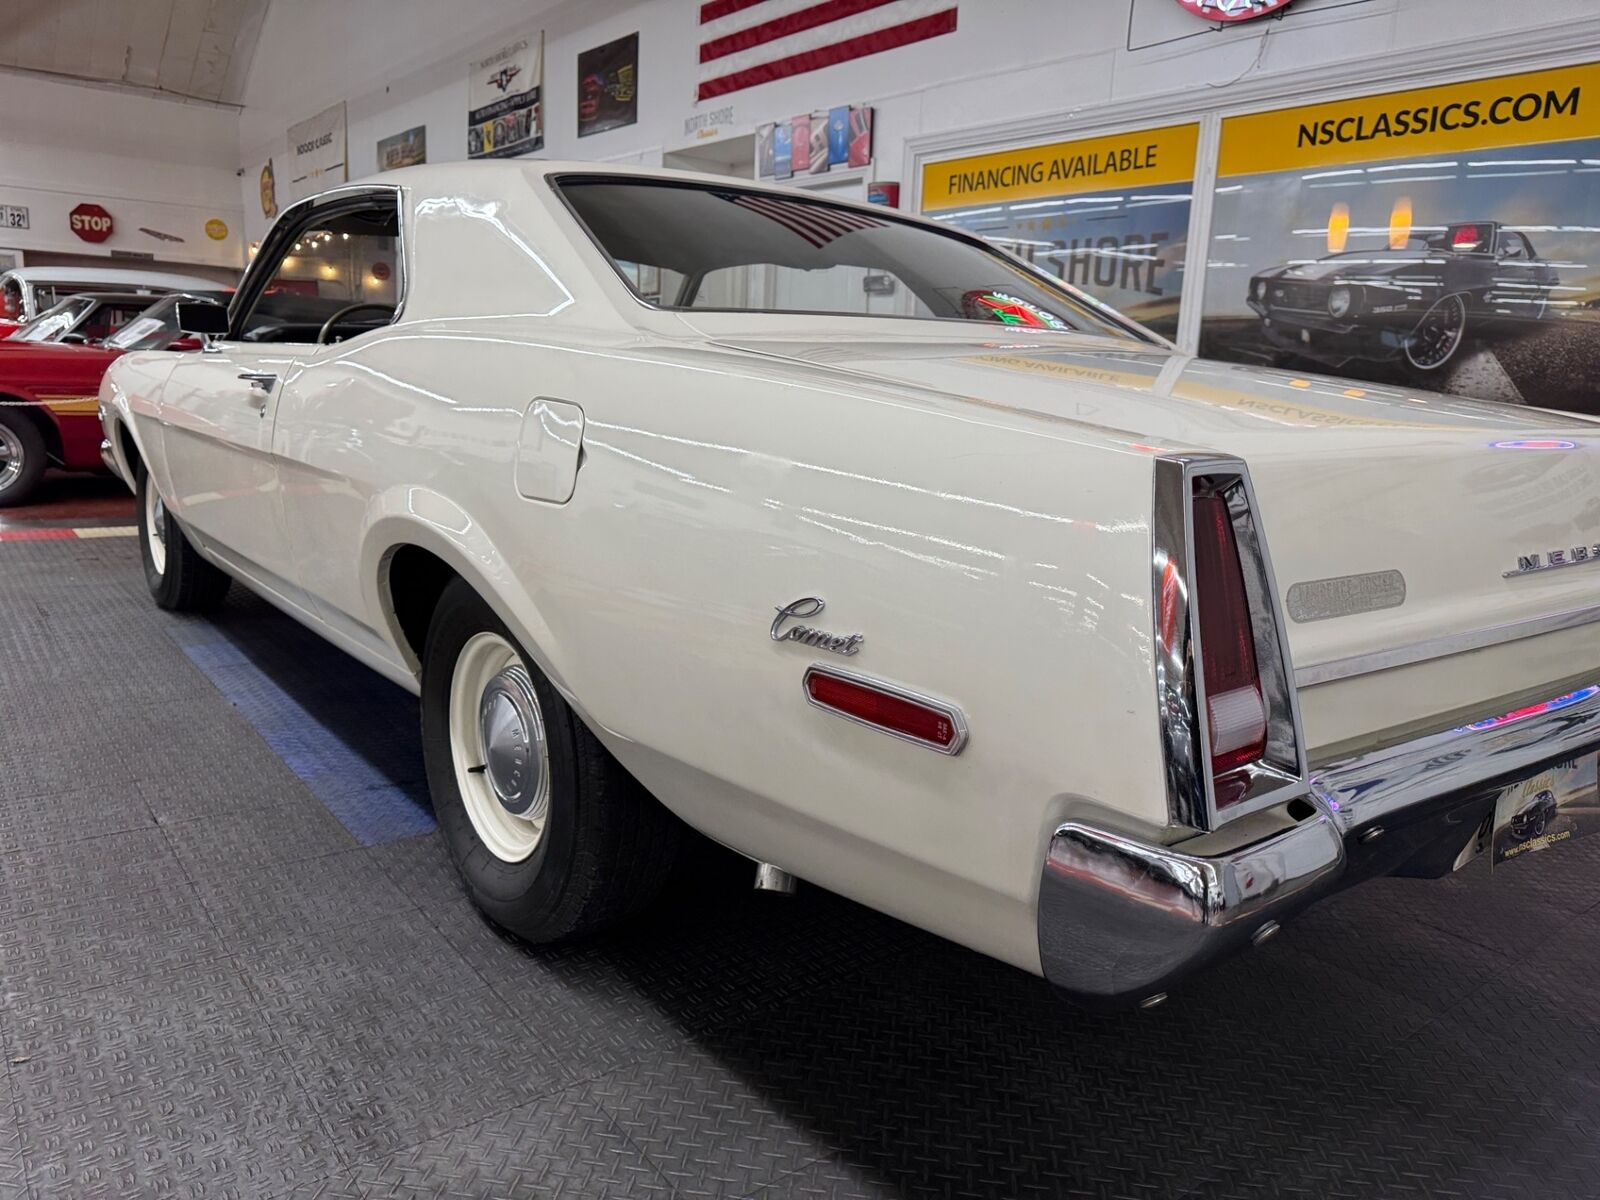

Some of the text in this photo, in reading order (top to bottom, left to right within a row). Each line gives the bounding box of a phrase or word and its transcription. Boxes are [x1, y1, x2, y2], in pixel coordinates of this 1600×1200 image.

[1297, 87, 1580, 148] NSCLASSICS.COM
[948, 145, 1157, 194] FINANCING AVAILABLE
[71, 214, 111, 232] STOP
[1047, 232, 1169, 296] SHORE
[770, 595, 864, 656] Comet
[1503, 830, 1571, 858] www.nsclassics.com
